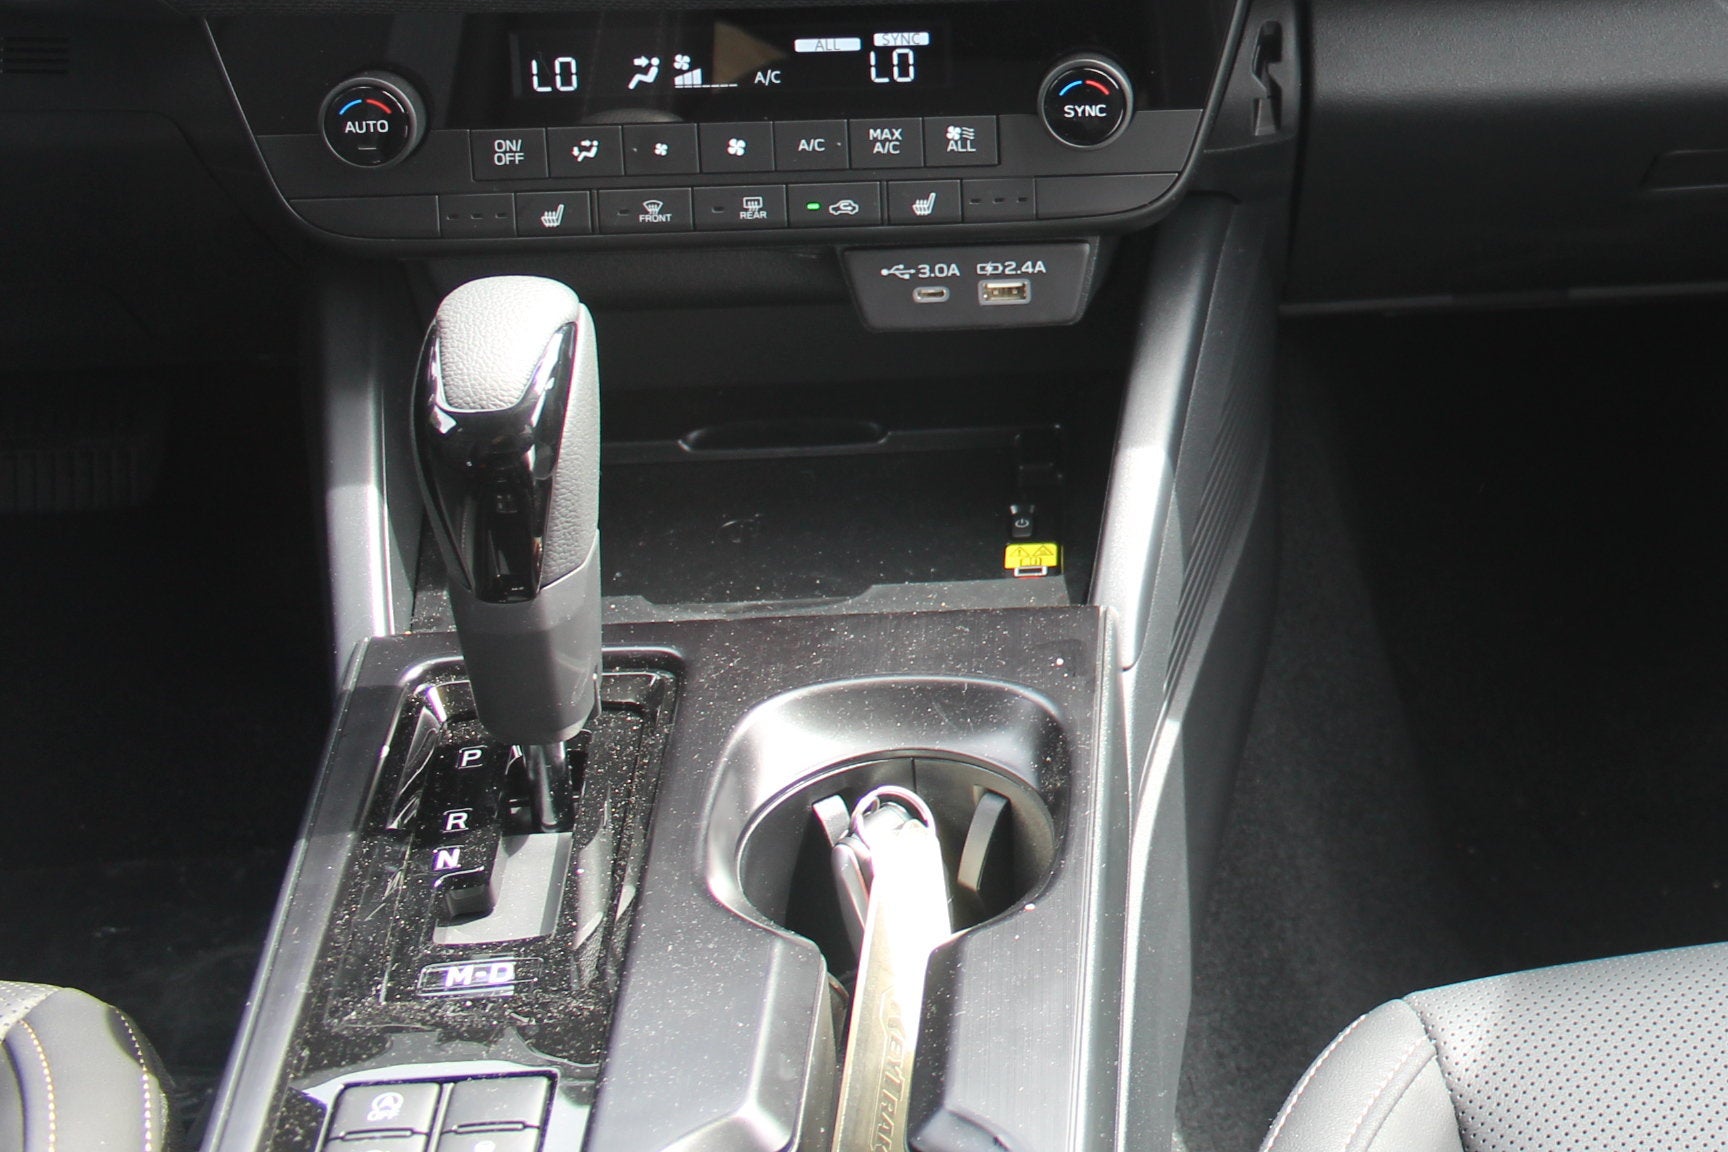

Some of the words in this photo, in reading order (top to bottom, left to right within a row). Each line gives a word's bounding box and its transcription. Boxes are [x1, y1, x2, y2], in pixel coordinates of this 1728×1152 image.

[815, 39, 841, 52] ALL
[882, 33, 920, 46] SYNC
[754, 69, 782, 86] A/C
[1063, 104, 1107, 118] SYNC
[344, 119, 389, 133] AUTO
[869, 128, 902, 141] MAX
[494, 139, 522, 152] ON/
[798, 138, 826, 153] A/C
[873, 141, 900, 154] A/C
[946, 140, 976, 152] ALL
[494, 153, 525, 165] OFF
[639, 213, 673, 223] FRONT
[739, 210, 767, 220] REAR
[918, 263, 961, 278] 3.0A
[1004, 260, 1046, 275] 2.4A
[461, 749, 482, 767] P
[446, 811, 468, 830] R
[435, 848, 460, 869] N
[366, 1109, 400, 1122] OFF
